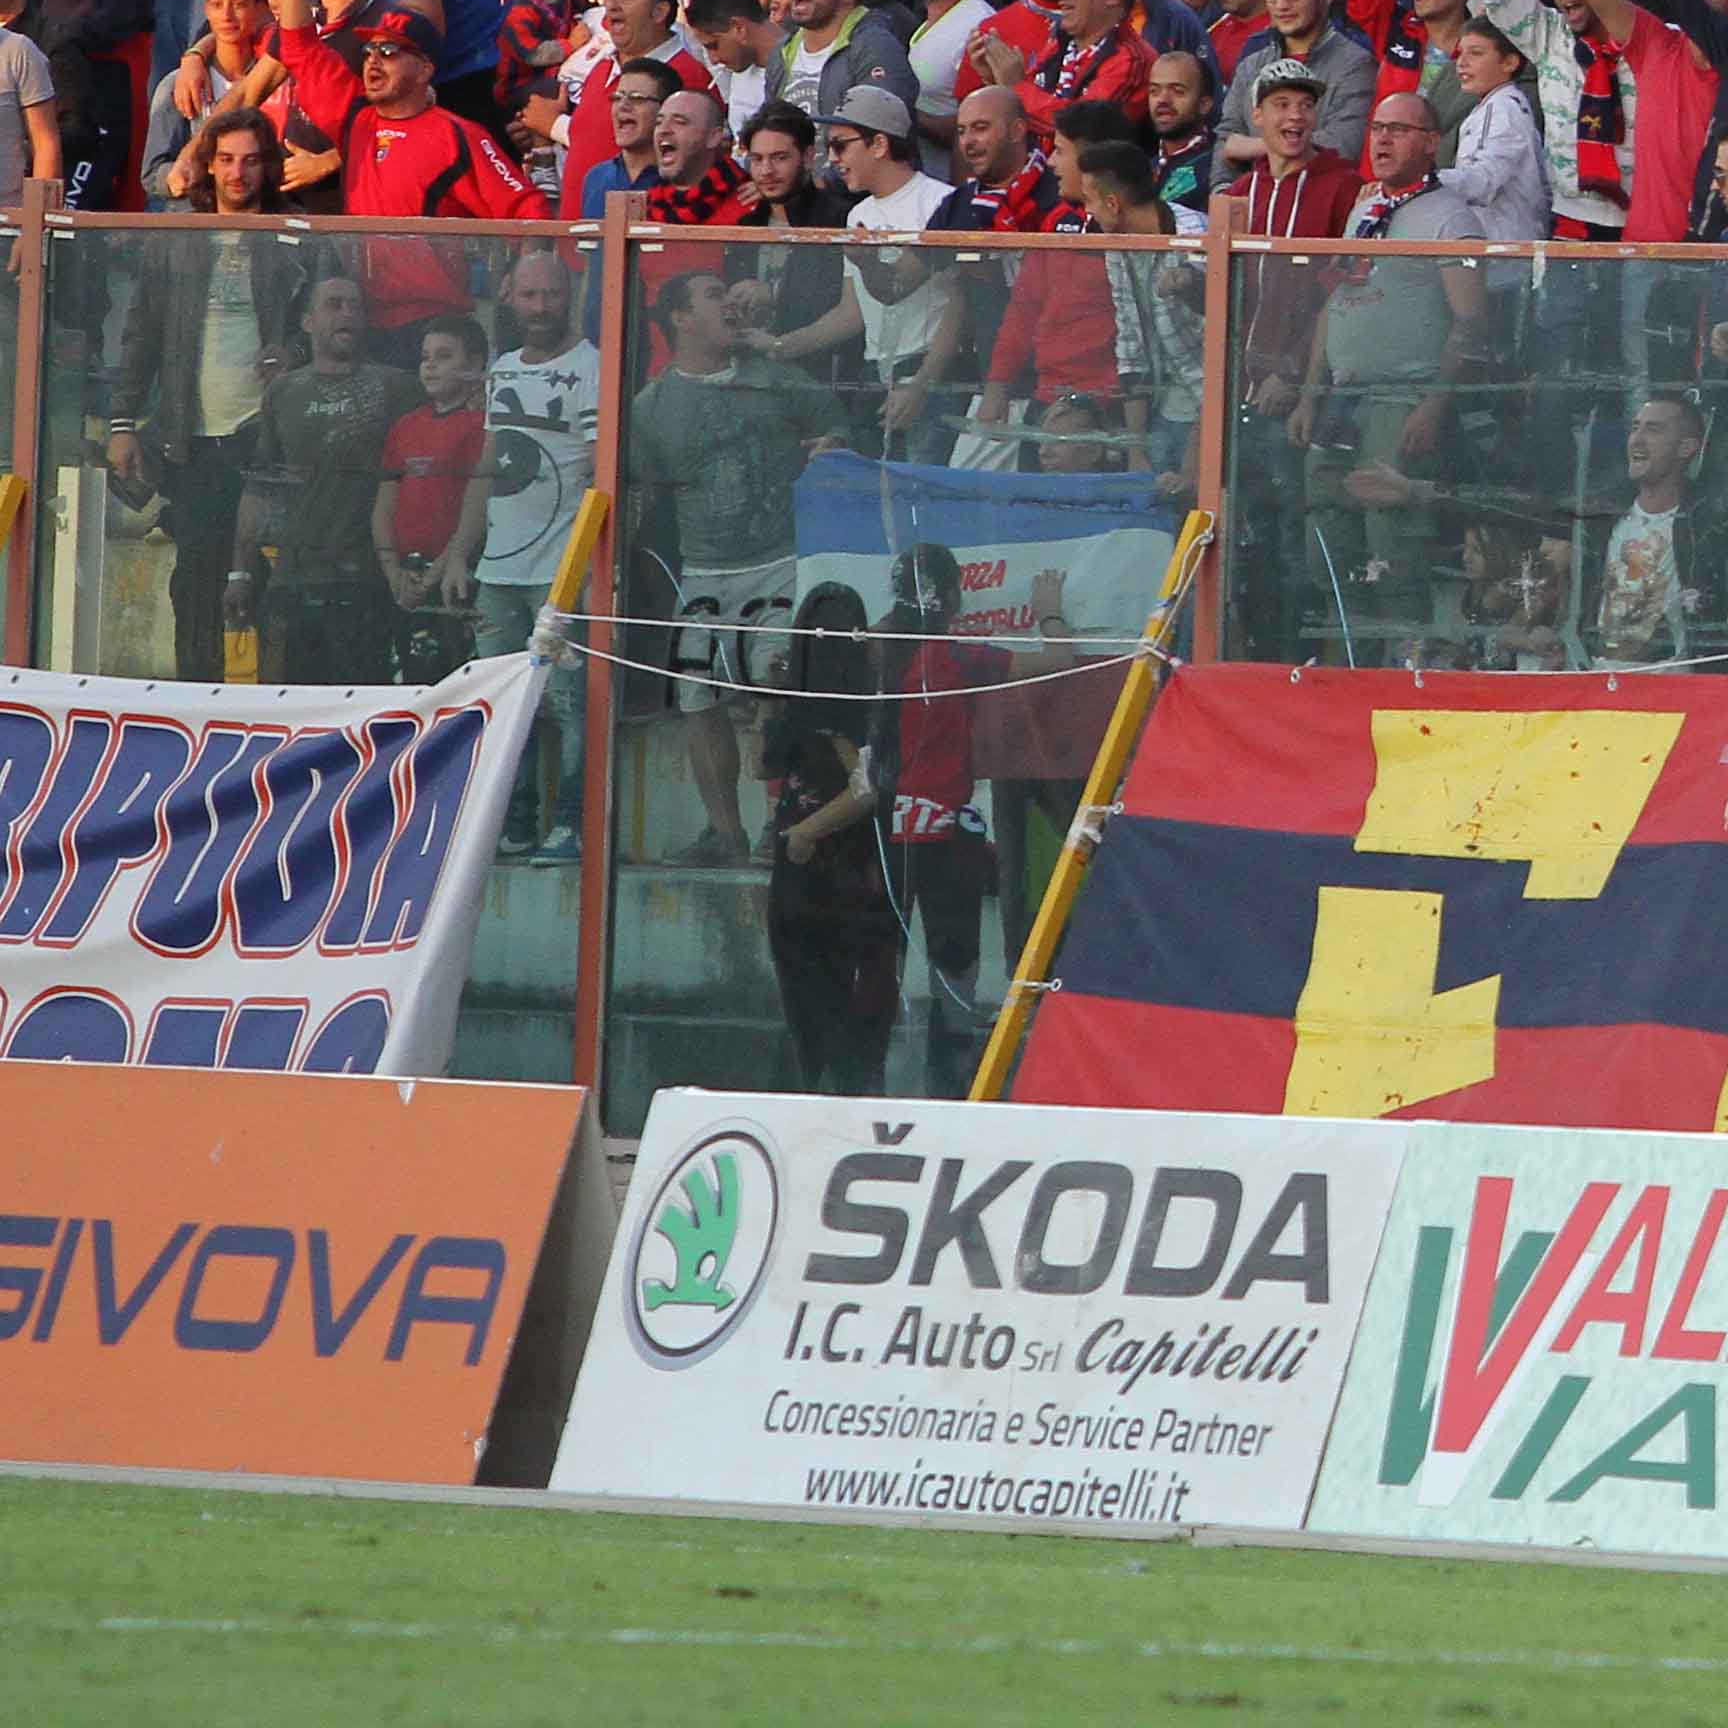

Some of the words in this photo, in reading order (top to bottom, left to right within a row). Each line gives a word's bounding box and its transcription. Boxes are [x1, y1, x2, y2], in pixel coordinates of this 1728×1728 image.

[479, 138, 524, 194] GIVOVA
[804, 1122, 1332, 1306] ŠKODA
[880, 1307, 1016, 1372] Auto
[1020, 1339, 1064, 1373] Srl
[1072, 1315, 1322, 1394] Capitelli
[762, 1387, 998, 1449] Concessionaria
[1002, 1411, 1023, 1446] e
[1032, 1401, 1146, 1452] Service
[1154, 1409, 1274, 1458] Partner
[804, 1464, 1191, 1523] www.icautocapitelli.it
